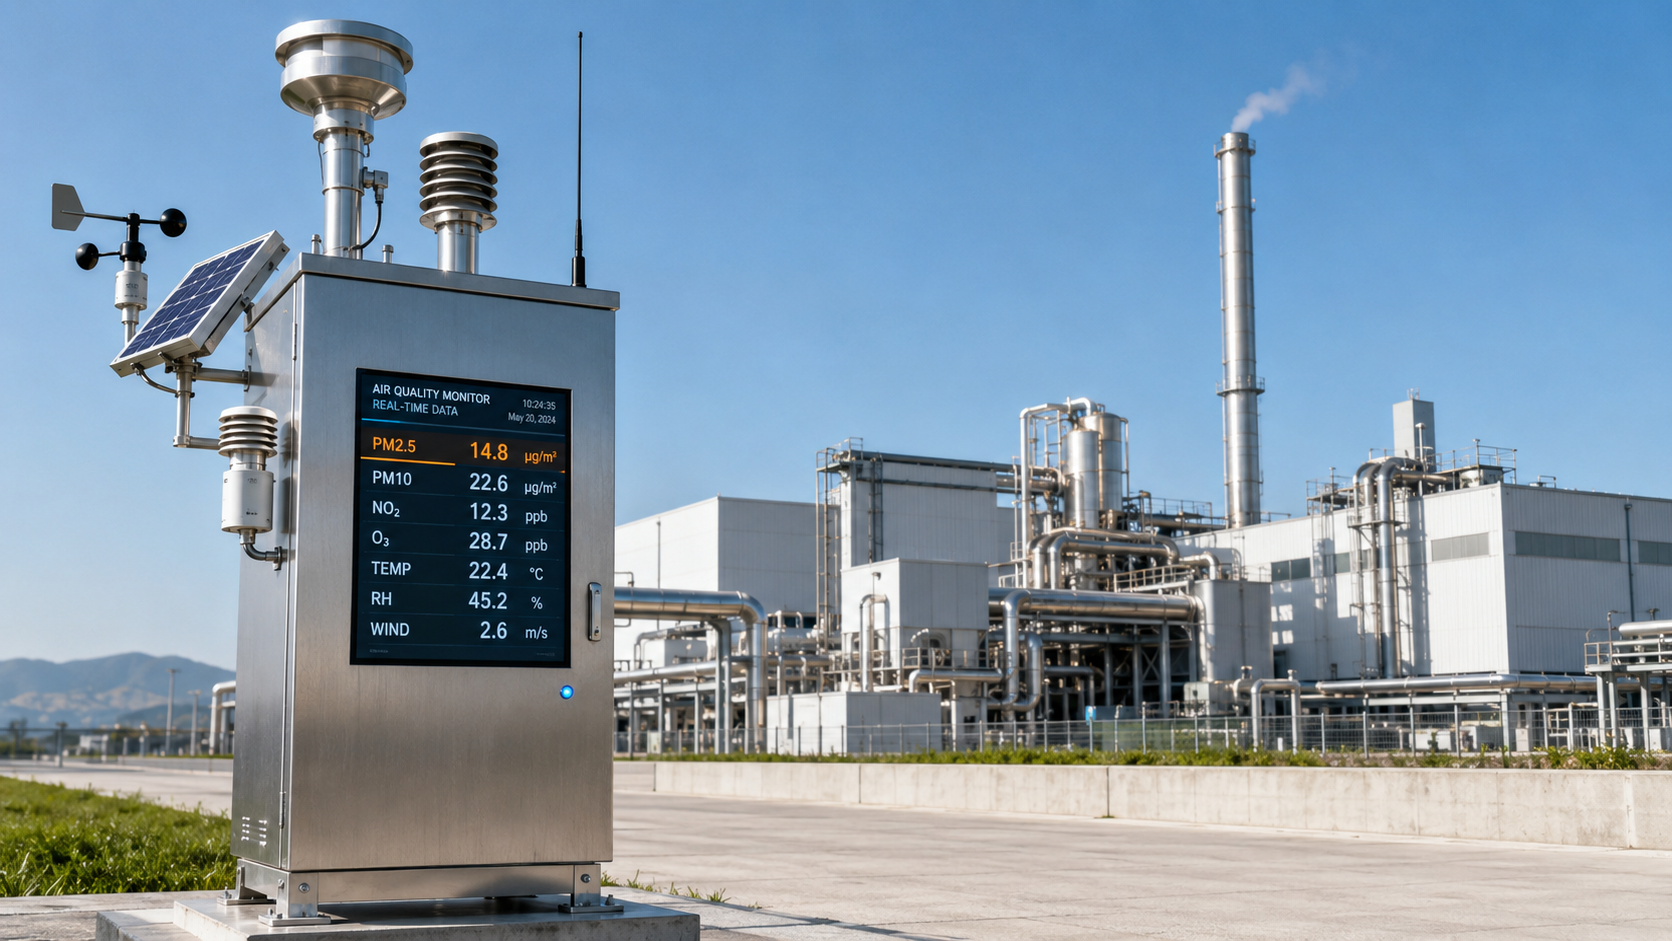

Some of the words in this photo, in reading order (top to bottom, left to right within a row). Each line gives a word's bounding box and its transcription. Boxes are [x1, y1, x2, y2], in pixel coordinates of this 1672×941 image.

[372, 383, 391, 395] AIR
[395, 385, 440, 400] QUALITY
[442, 390, 491, 404] MONITOR
[372, 400, 429, 414] REAL-TIME
[432, 404, 458, 416] DATA
[523, 399, 556, 410] 10:24:35
[508, 412, 524, 424] May
[525, 413, 536, 423] 20,
[537, 414, 556, 424] 2024
[372, 436, 416, 453] PM2.5
[470, 441, 508, 461] 14.8
[372, 470, 412, 486] PM10
[469, 472, 508, 492] 22.6
[470, 502, 508, 521] 12.3
[525, 510, 548, 525] ppb
[469, 531, 508, 551] 28.7
[525, 538, 548, 553] ppb
[371, 560, 411, 576] TEMP
[469, 561, 508, 580] 22.4
[371, 591, 392, 605] RH
[468, 591, 508, 610] 45.2
[531, 596, 543, 609] %
[371, 622, 410, 636] WIND
[480, 621, 508, 639] 2.6
[525, 626, 548, 639] m/s
